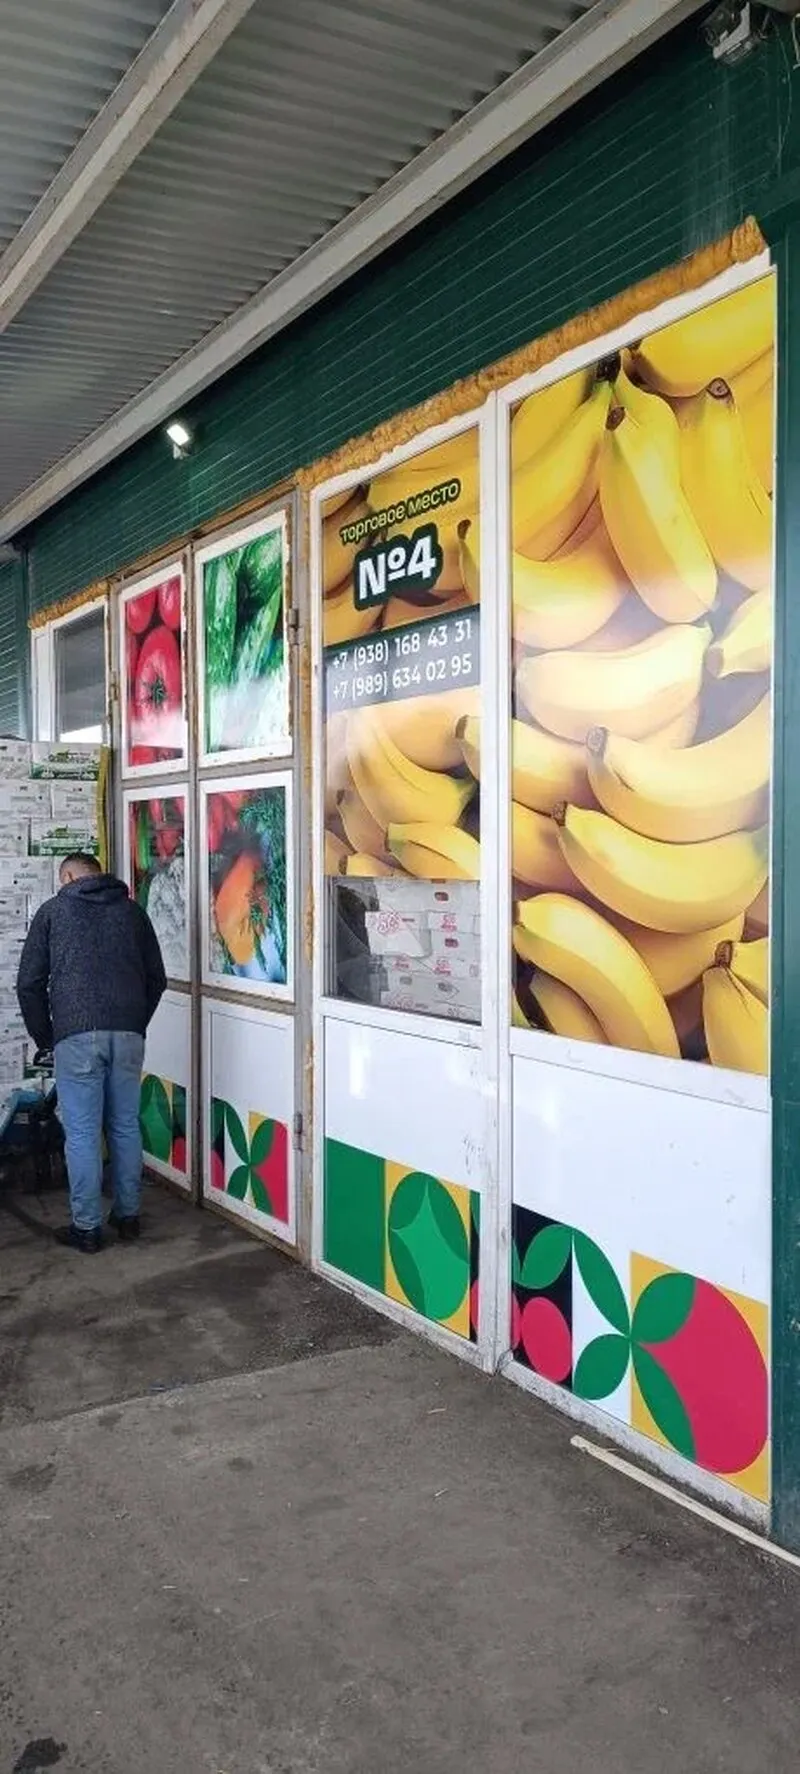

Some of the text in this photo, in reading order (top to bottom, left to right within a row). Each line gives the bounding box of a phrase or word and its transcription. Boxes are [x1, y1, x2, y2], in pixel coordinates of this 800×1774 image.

[341, 505, 406, 542] торговое
[358, 535, 437, 600] №4
[332, 618, 472, 672] +7 (938) 168 43 31
[332, 653, 473, 701] +7 (989) 634 02 95
